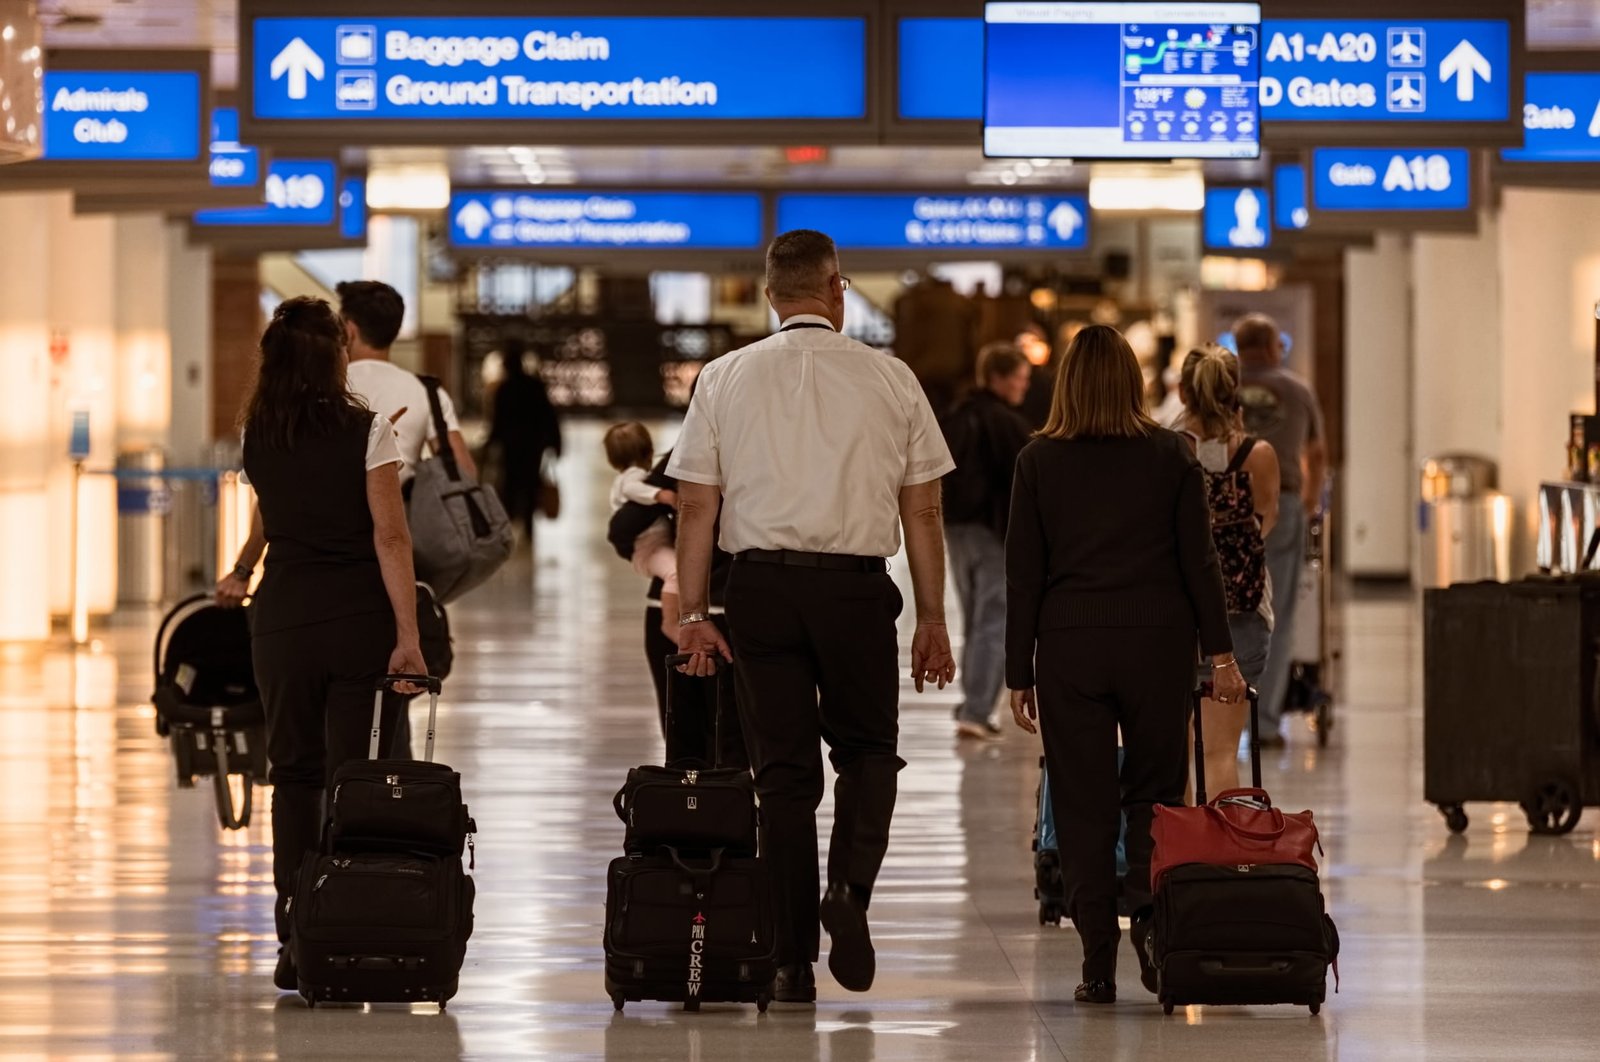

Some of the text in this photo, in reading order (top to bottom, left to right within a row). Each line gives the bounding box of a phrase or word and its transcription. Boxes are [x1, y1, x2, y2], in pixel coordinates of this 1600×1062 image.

[385, 30, 610, 66] Baggage Claim
[1266, 32, 1377, 62] A1-A20
[52, 87, 149, 112] Admirals
[385, 75, 717, 110] Ground Transportation
[1259, 77, 1283, 106] D
[1287, 76, 1376, 107] Gates
[73, 118, 128, 143] Club
[1329, 163, 1377, 186] Gate
[686, 940, 703, 997] CREW
